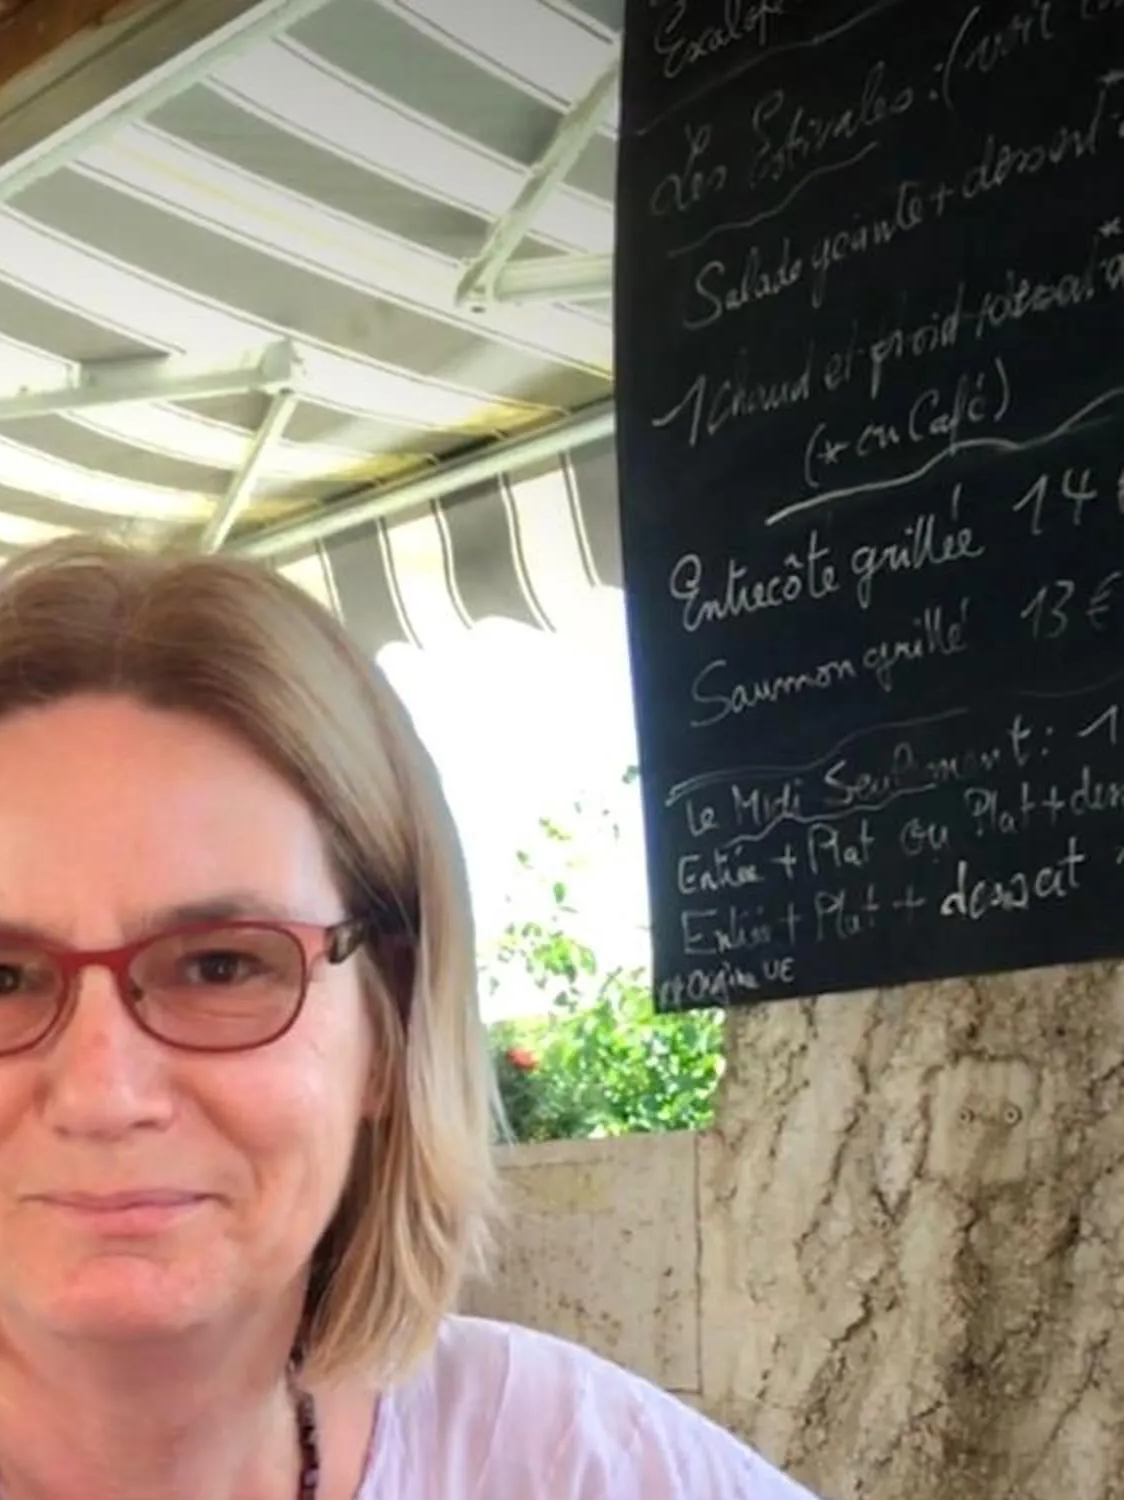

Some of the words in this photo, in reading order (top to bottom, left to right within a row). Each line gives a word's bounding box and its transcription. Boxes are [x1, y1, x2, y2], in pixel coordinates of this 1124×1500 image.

[649, 122, 728, 217] Les
[682, 237, 803, 331] Salade
[669, 529, 840, 632] Entrecôte
[850, 483, 986, 610] grillée
[688, 658, 857, 728] Saumon
[862, 598, 970, 692] grillé
[807, 817, 875, 877] Plat
[963, 781, 1036, 837] Plat
